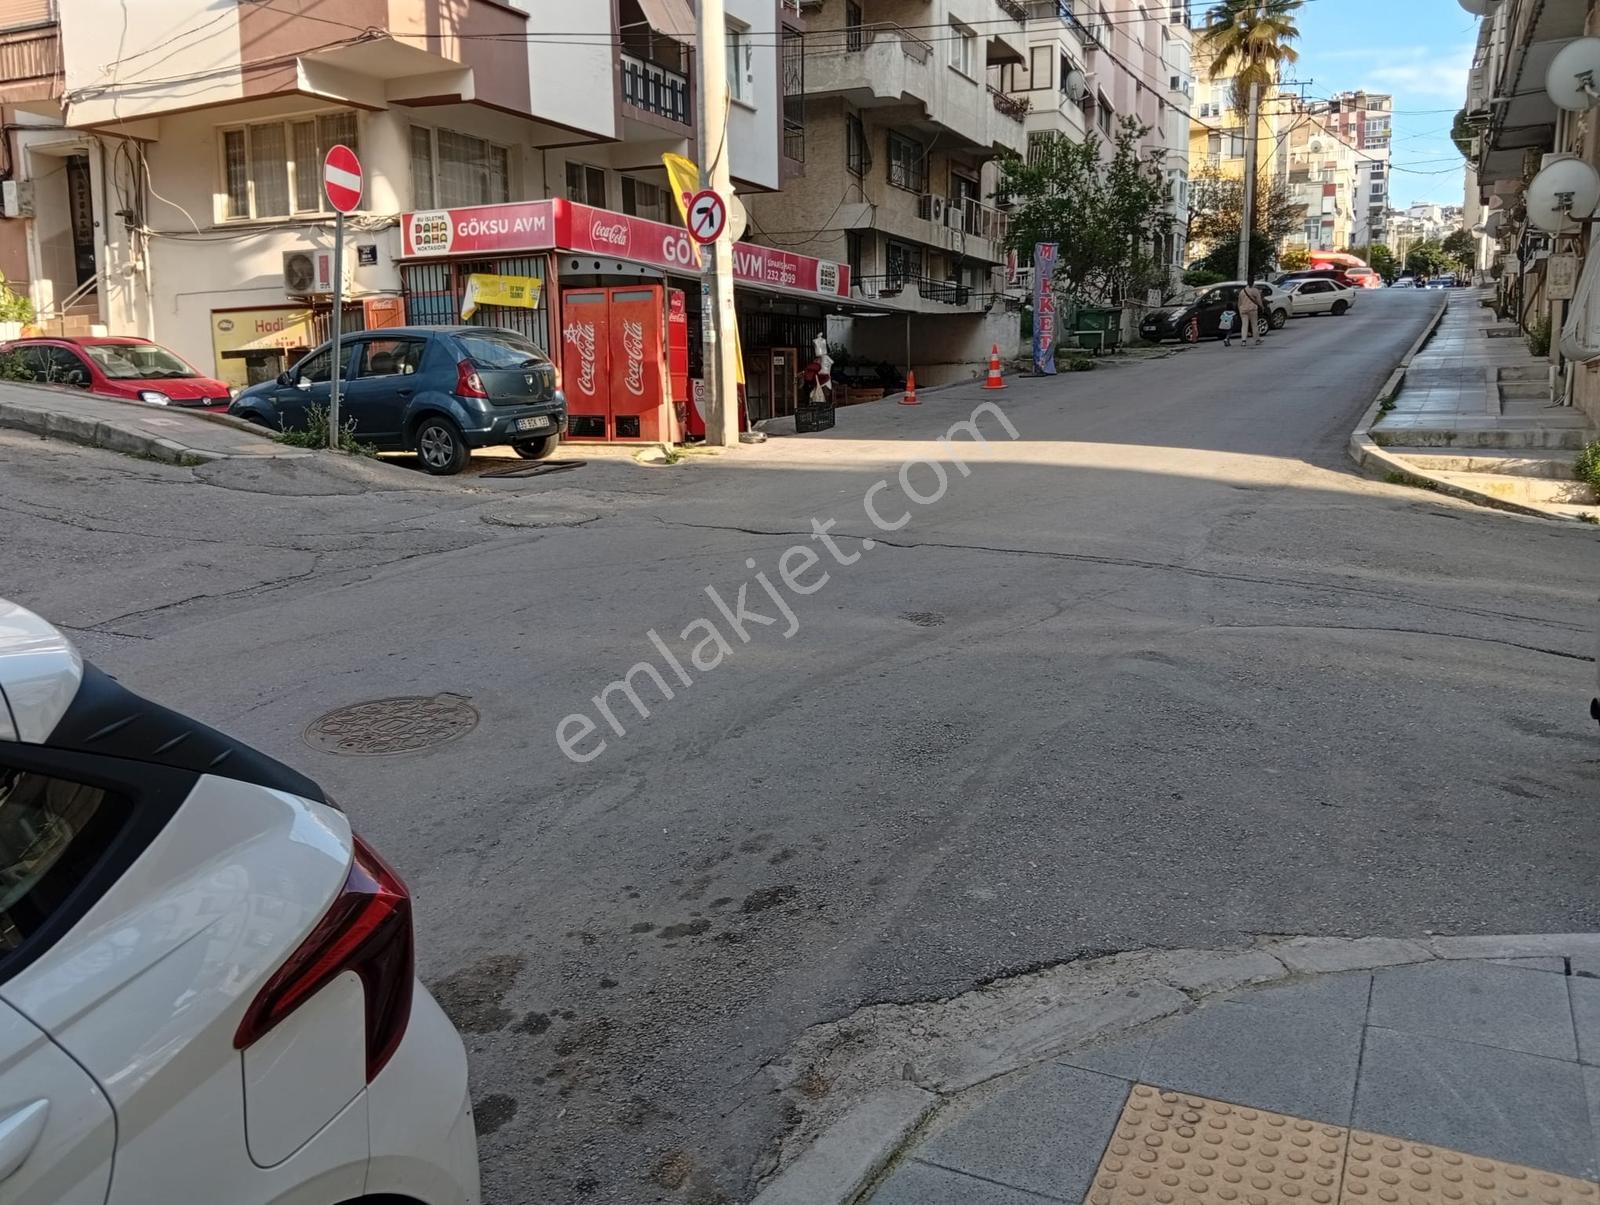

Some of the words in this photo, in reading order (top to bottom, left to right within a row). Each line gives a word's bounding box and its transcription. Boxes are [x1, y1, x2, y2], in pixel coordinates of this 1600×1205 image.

[415, 221, 447, 234] DAHA
[457, 217, 509, 237] GÖKSU
[513, 216, 546, 233] AVM
[415, 233, 448, 245] DAHA
[732, 250, 762, 279] AVM
[767, 269, 779, 281] 232
[254, 318, 285, 334] Hadi
